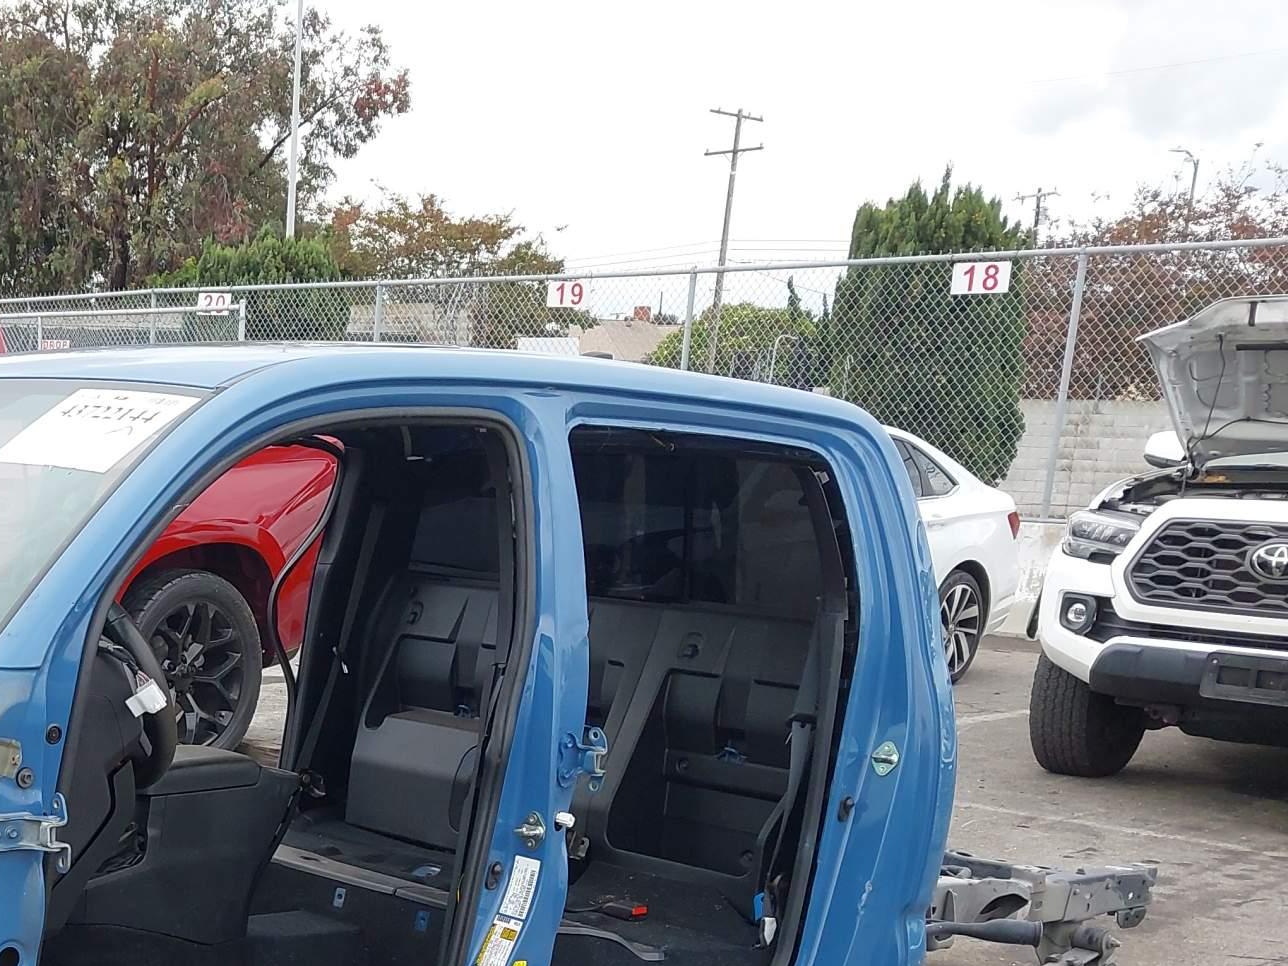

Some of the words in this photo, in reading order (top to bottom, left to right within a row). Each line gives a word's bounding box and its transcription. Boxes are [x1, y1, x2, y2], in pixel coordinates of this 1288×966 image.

[963, 264, 1000, 292] 18
[203, 294, 226, 314] 20
[556, 282, 584, 306] 19
